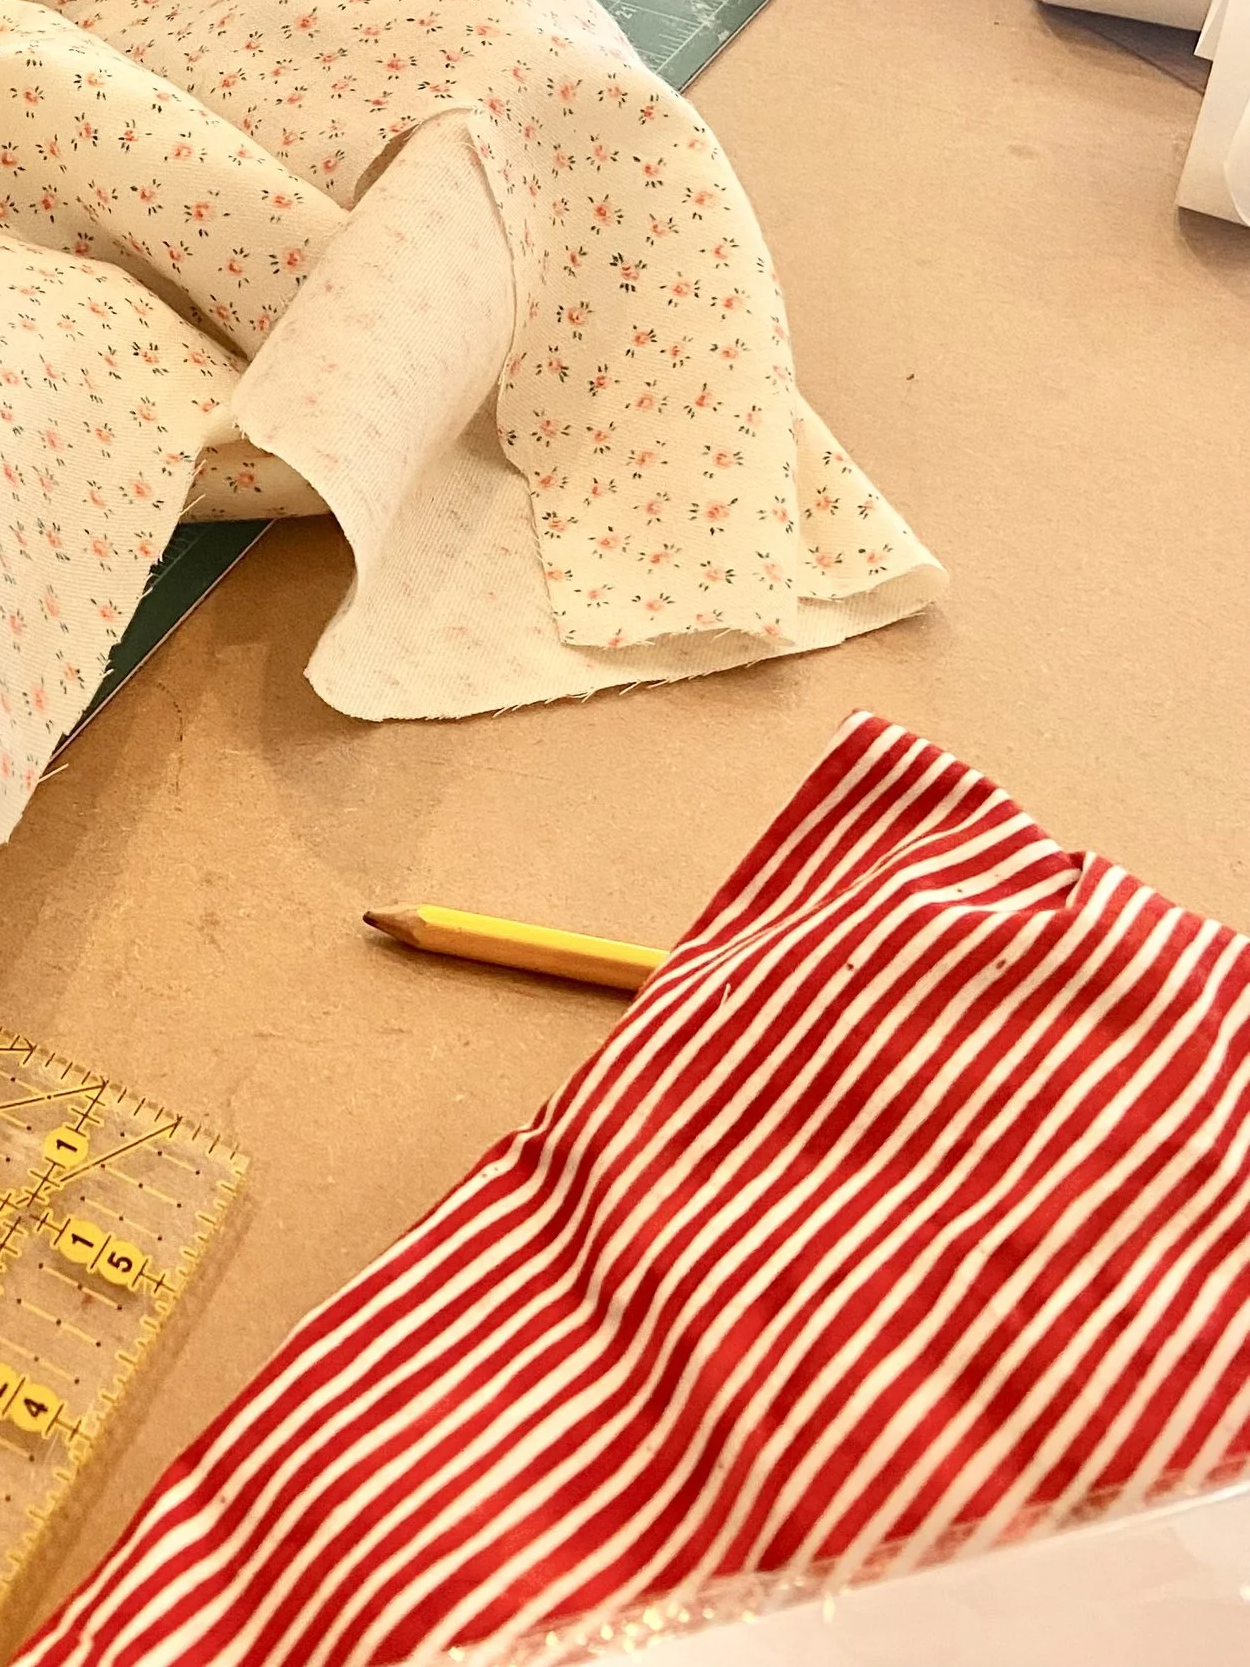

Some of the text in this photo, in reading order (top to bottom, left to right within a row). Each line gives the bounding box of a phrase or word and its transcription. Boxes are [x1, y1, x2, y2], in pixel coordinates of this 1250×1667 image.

[55, 1138, 79, 1153] 1
[71, 1233, 95, 1248] 1
[107, 1251, 134, 1273] 5
[22, 1397, 49, 1418] 4
